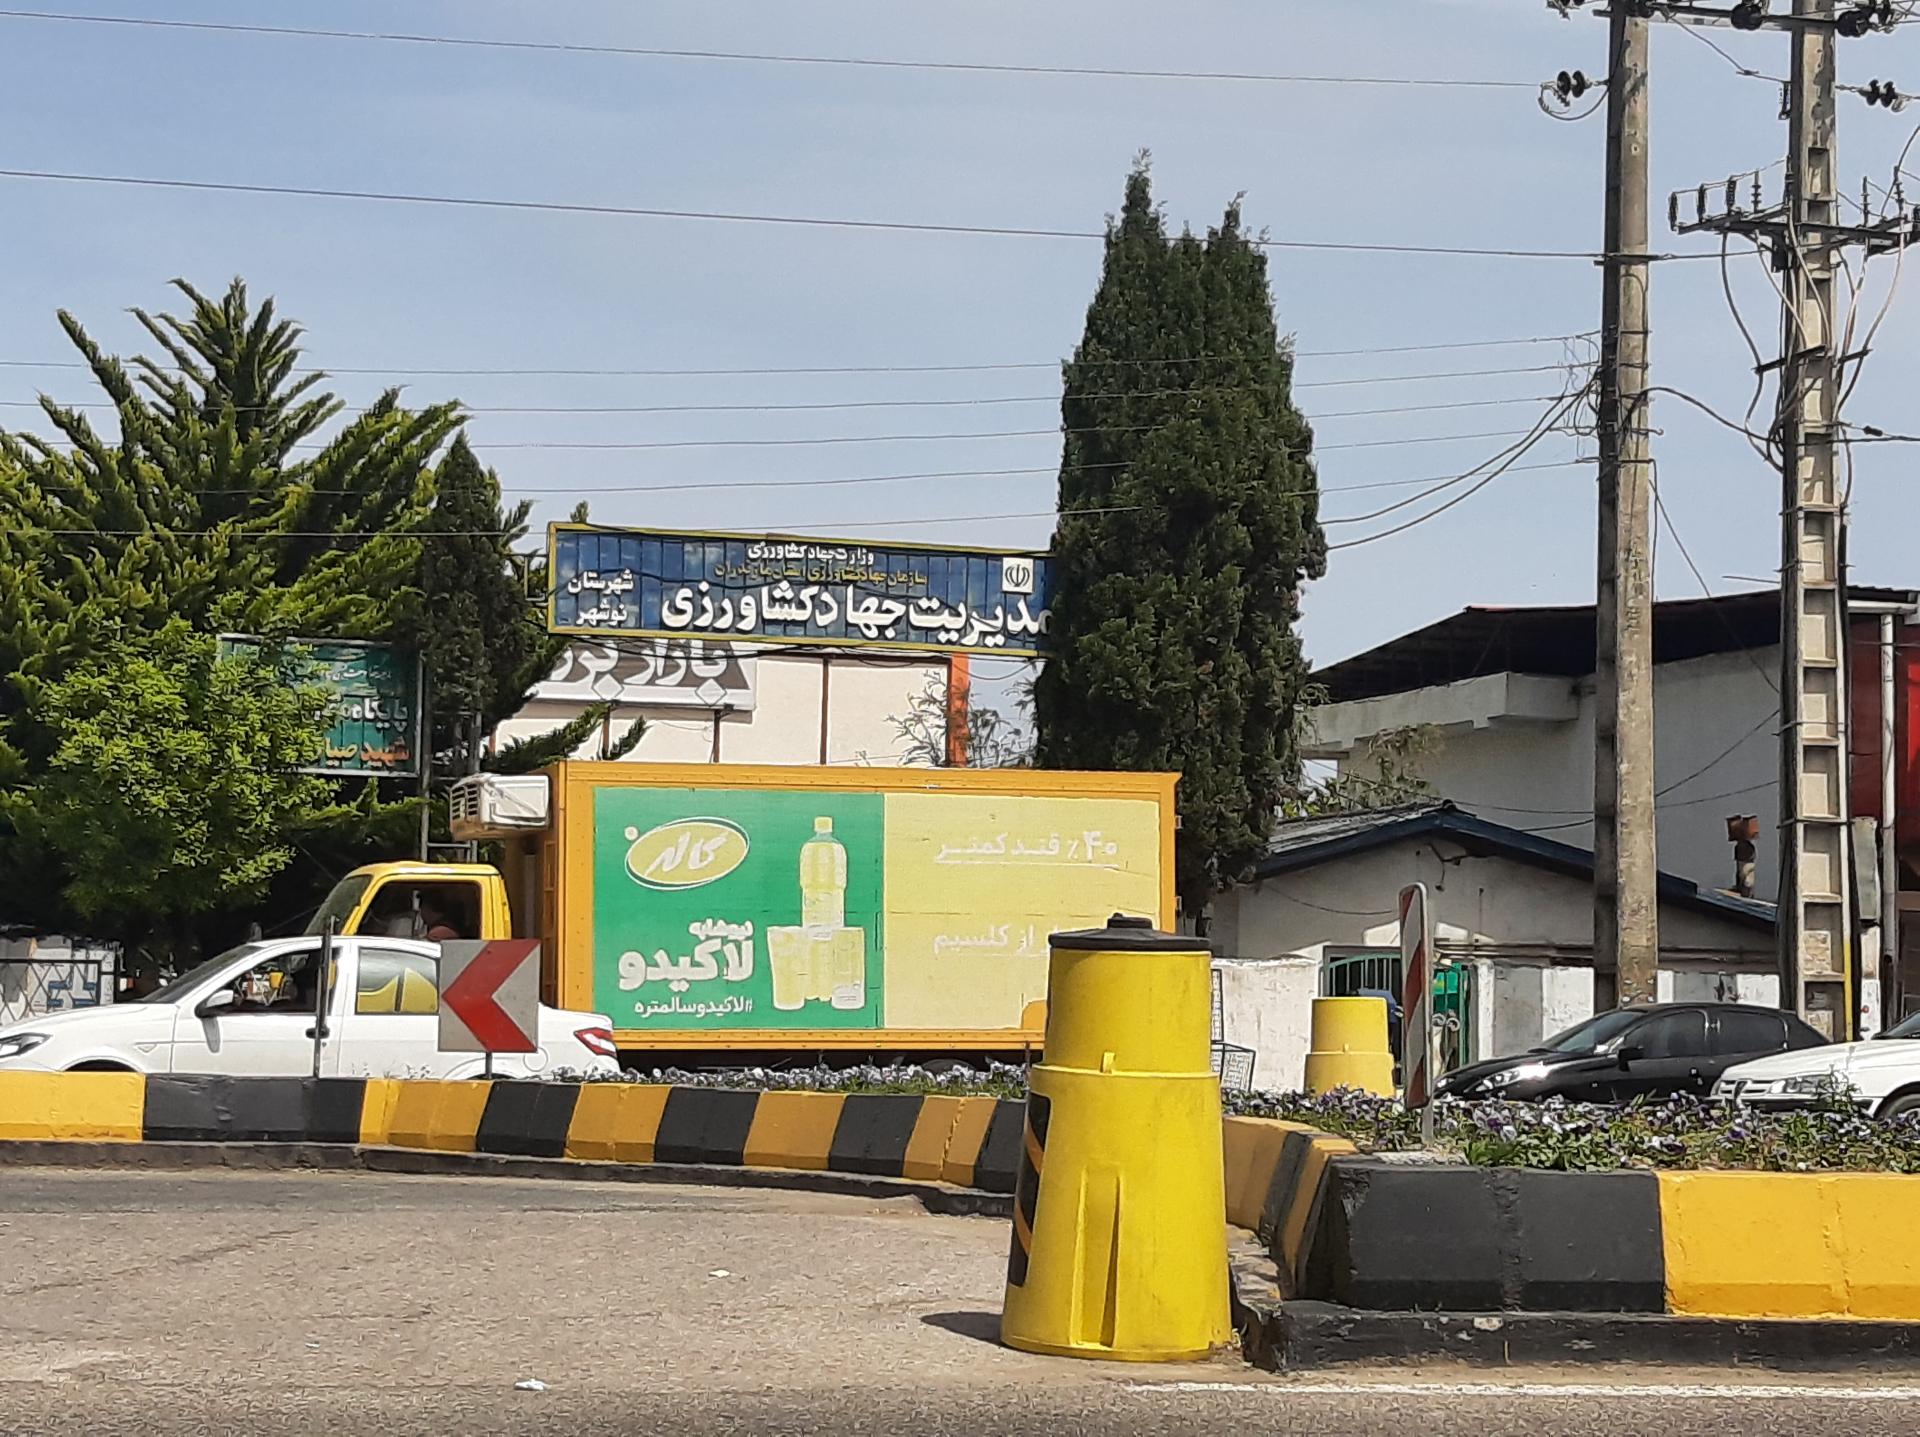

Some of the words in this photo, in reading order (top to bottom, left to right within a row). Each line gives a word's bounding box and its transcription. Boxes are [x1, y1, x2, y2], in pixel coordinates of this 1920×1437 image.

[747, 540, 808, 560] کشاورزی
[836, 546, 874, 566] وزارت
[567, 567, 635, 595] شهرستان
[887, 568, 928, 587] سازمان
[575, 599, 628, 627] نوشهر
[661, 579, 820, 632] کشاورزی
[816, 584, 907, 640] جهاد
[909, 596, 1052, 648] مدیریت
[352, 697, 408, 733] پایگاه
[363, 736, 411, 768] شهید
[934, 831, 1009, 862] کمتر
[1010, 832, 1061, 856] قند
[934, 923, 1012, 955] کلسیم
[617, 937, 754, 991] لاکیدو
